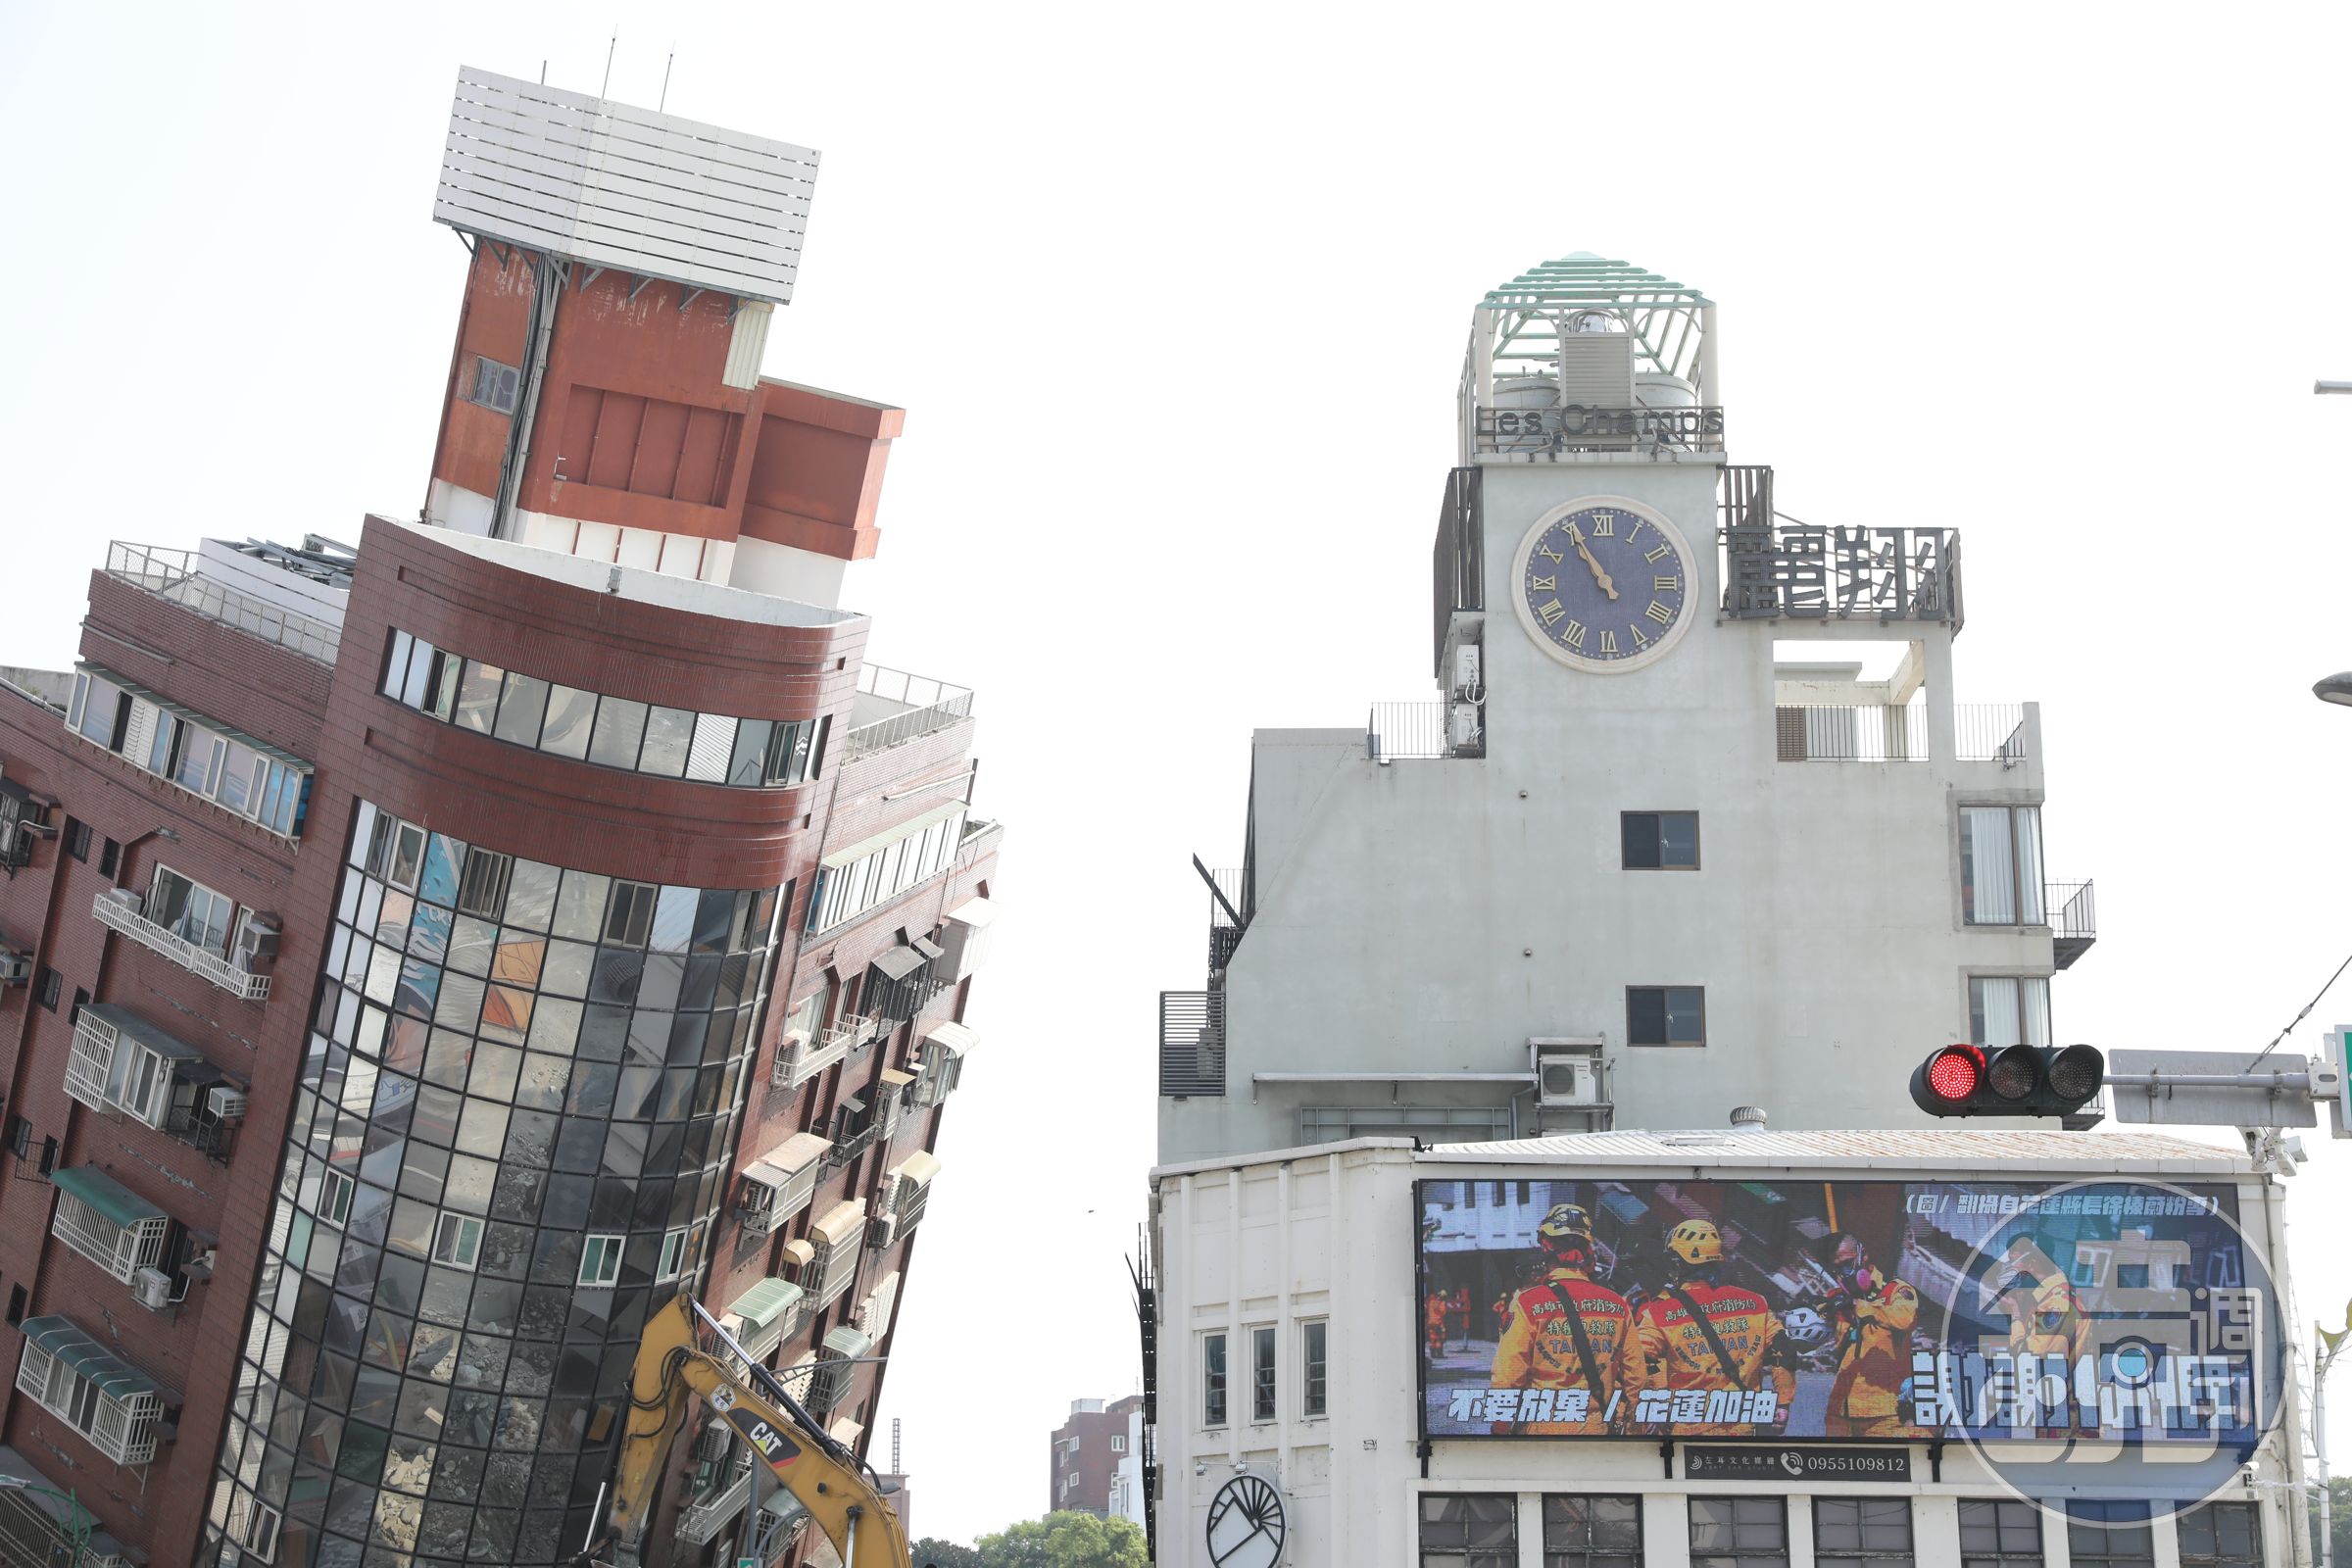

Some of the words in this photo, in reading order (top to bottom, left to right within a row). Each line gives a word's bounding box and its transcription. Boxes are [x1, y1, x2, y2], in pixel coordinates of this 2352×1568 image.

[1476, 405, 1543, 435] Les
[1560, 404, 1724, 440] Champs
[1592, 514, 1615, 537] XII
[1626, 522, 1642, 544] I
[1540, 544, 1564, 564] X
[1644, 543, 1670, 564] II
[1654, 575, 1678, 591] III
[1631, 623, 1648, 647] V
[1912, 1351, 2235, 1429] 謝謝你們
[1446, 1388, 1591, 1423] 不要放棄
[1635, 1389, 1779, 1424] 花蓮加油
[750, 1422, 783, 1456] CAT
[1808, 1456, 1904, 1472] 0955109812
